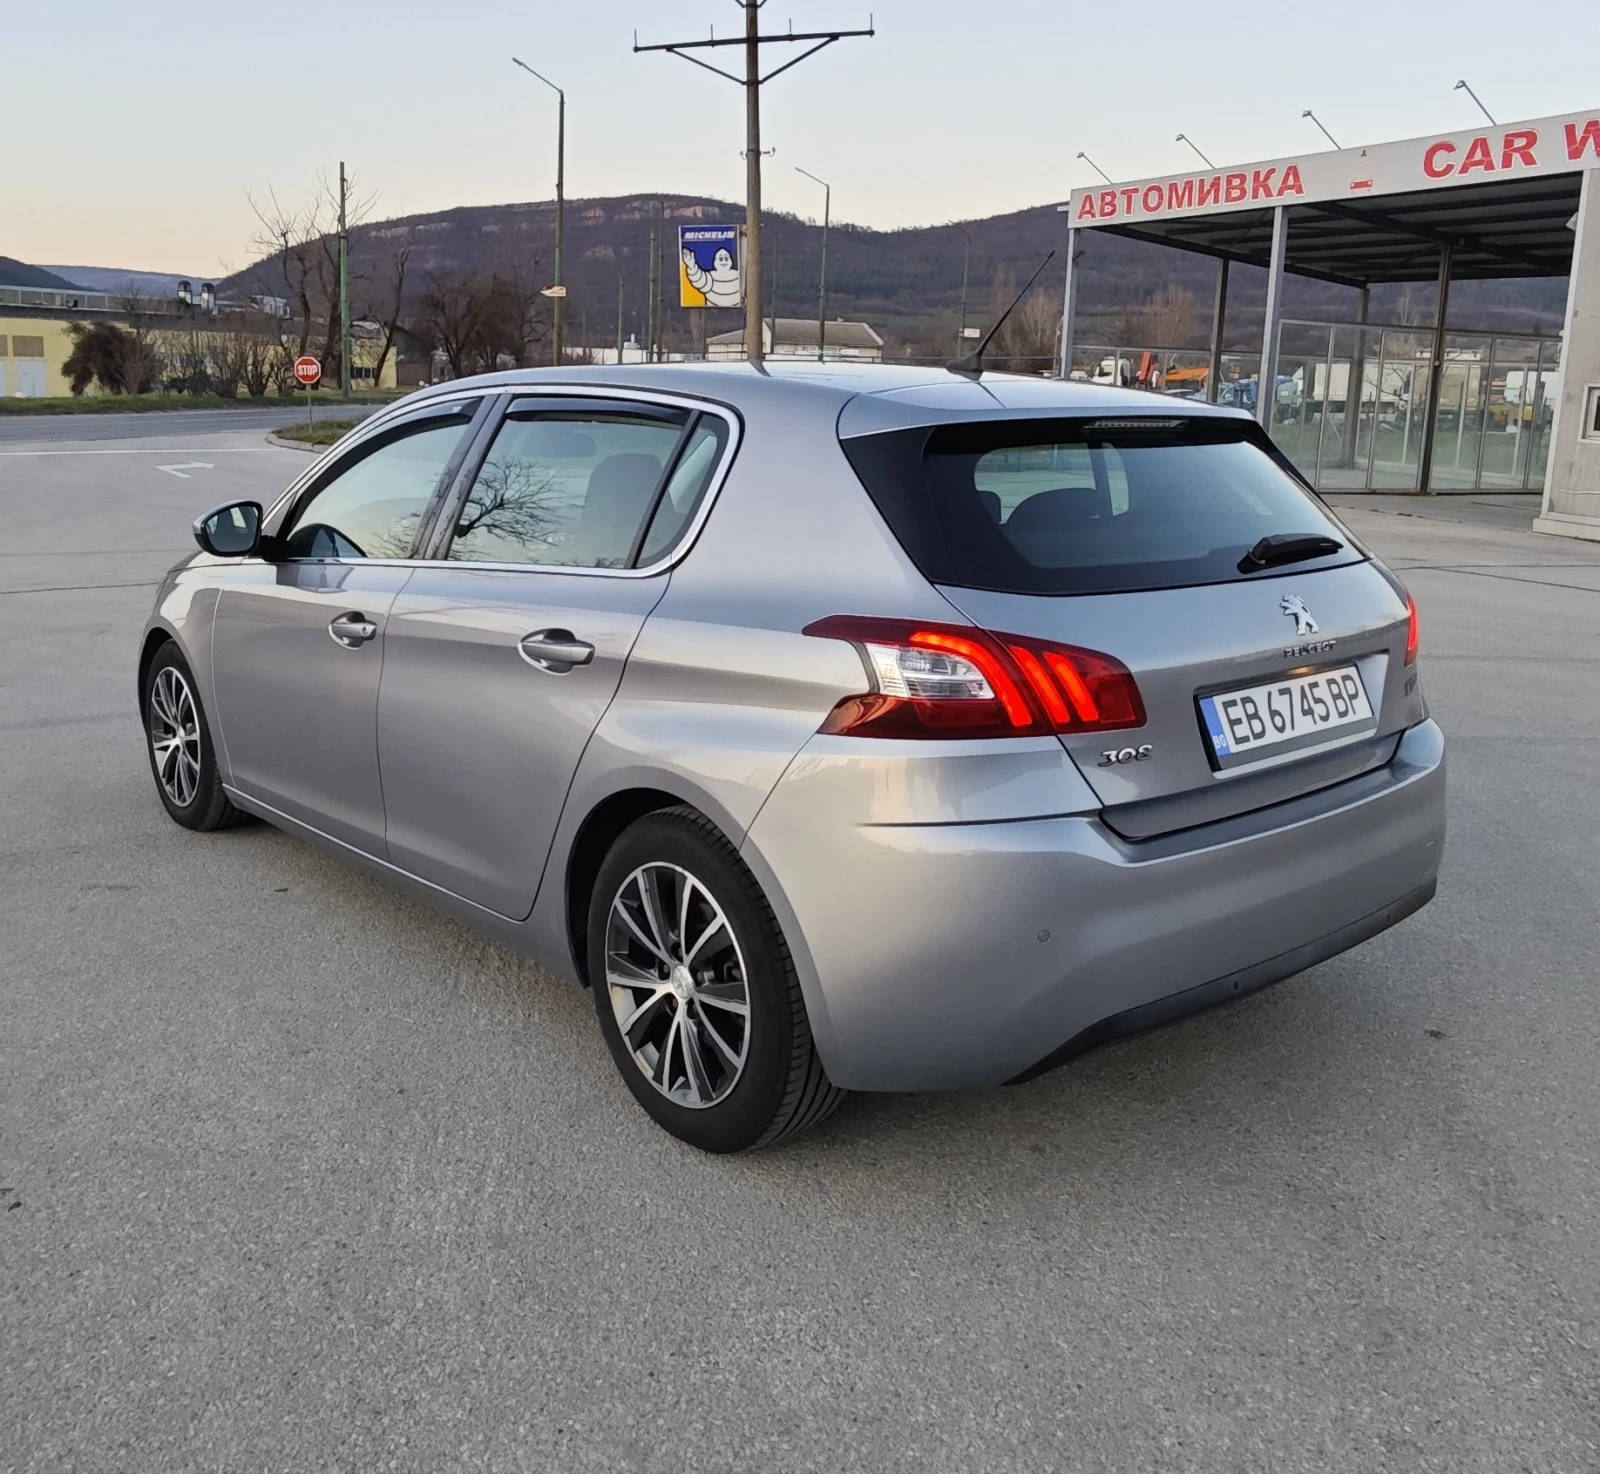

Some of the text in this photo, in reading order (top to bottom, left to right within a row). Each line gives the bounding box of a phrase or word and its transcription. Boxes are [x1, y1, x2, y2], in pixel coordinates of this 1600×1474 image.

[1422, 129, 1539, 180] CAR
[1076, 164, 1305, 221] АВТОМИВКА
[684, 231, 736, 239] MICHELIN
[298, 364, 318, 376] STOP
[1284, 639, 1337, 658] PEUGEOT
[1213, 734, 1228, 750] BG
[1097, 743, 1153, 767] 308
